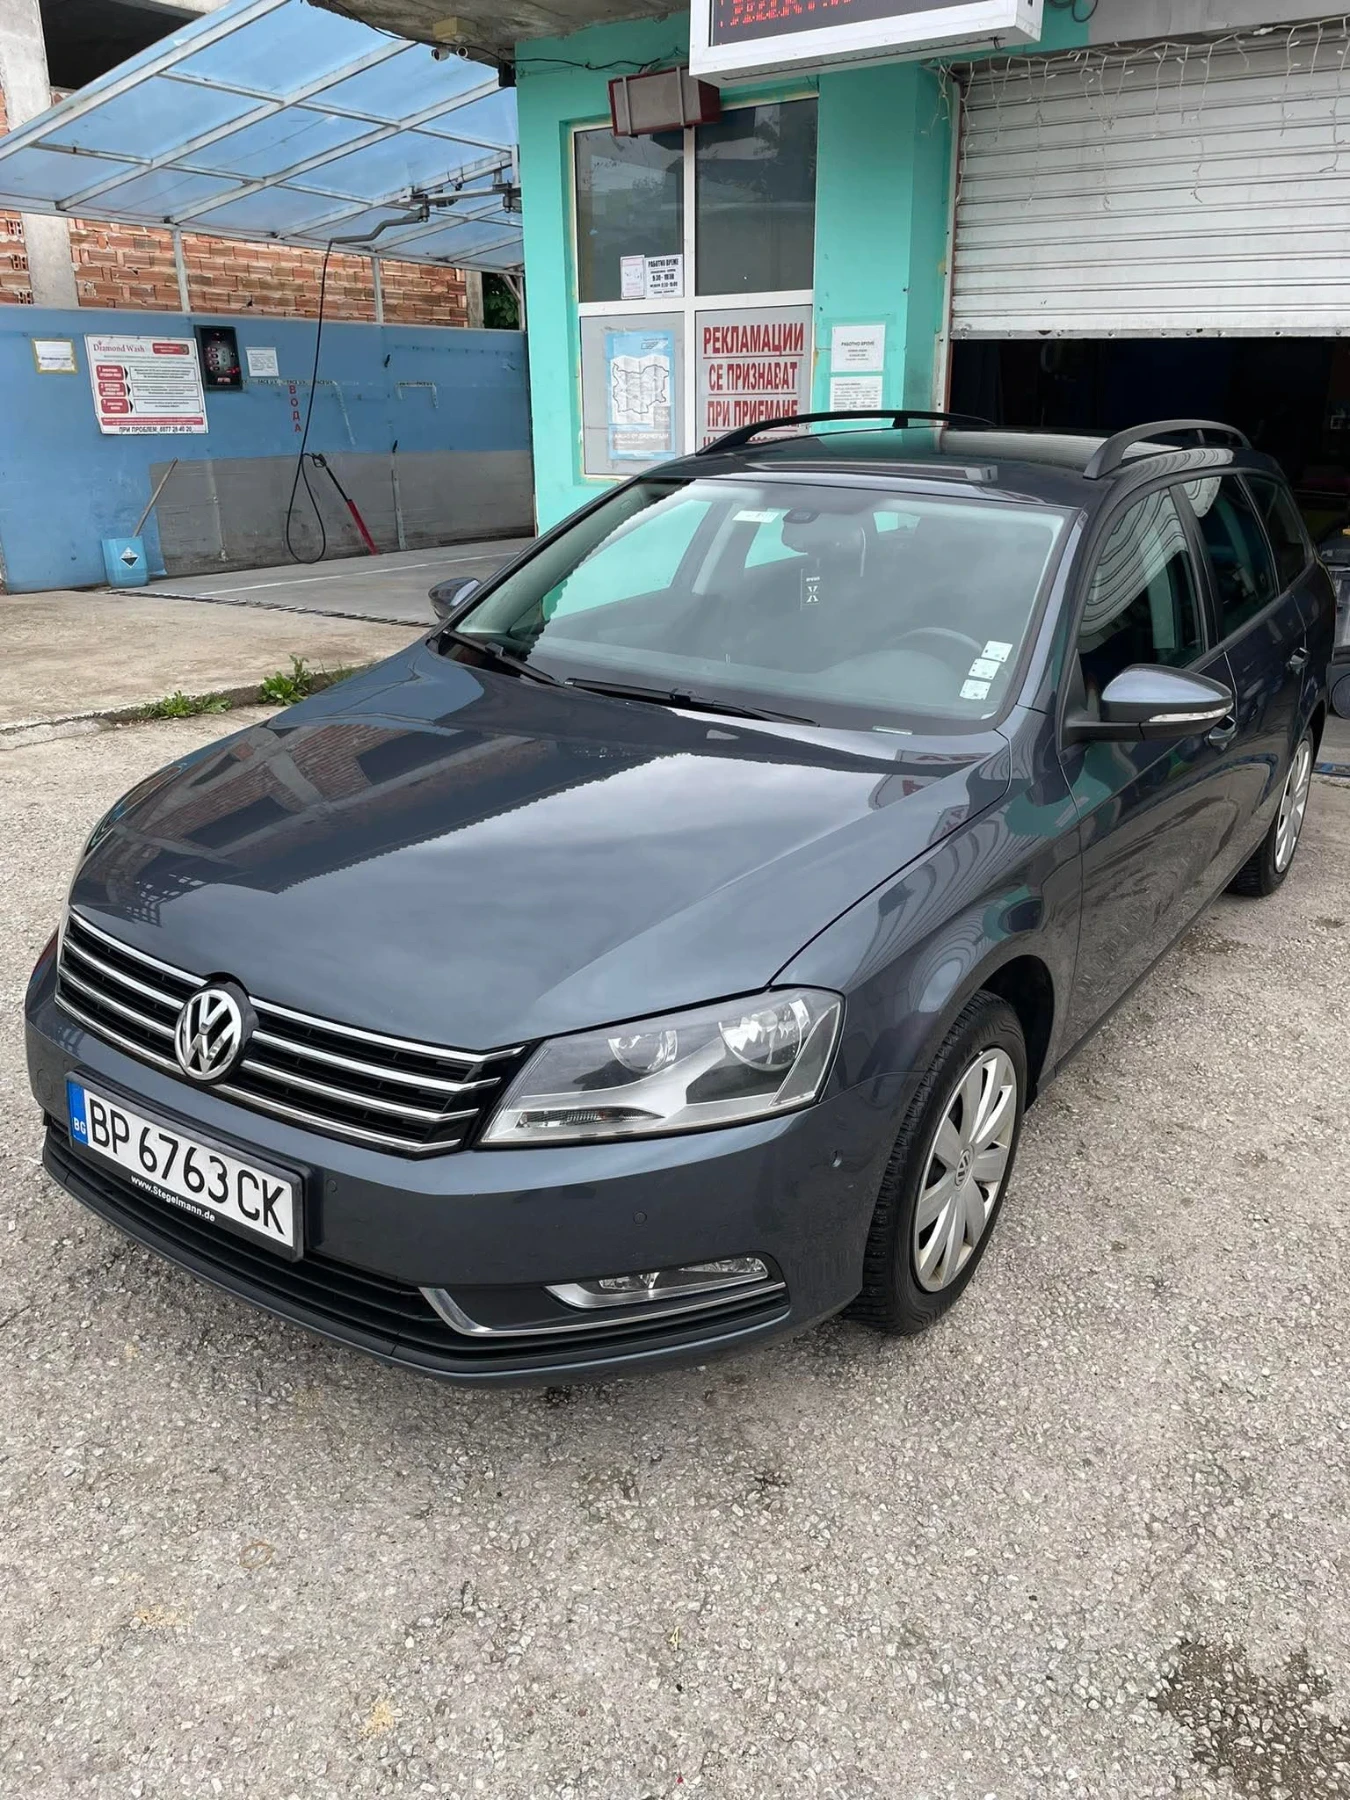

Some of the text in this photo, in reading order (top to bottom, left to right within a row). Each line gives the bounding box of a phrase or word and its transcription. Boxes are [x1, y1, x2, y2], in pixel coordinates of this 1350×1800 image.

[93, 342, 126, 353] Diamond
[126, 344, 145, 353] Wash
[703, 322, 804, 355] РЕКЛАМАЦИИ
[709, 362, 798, 391] СЕ ПРИЗНАВАТ
[289, 385, 301, 432] ВОДА
[707, 400, 730, 428] ПРИ
[73, 1117, 87, 1136] BG
[89, 1098, 286, 1236] BP 6763 CK
[130, 1174, 216, 1222] www.Stegelmann.de
